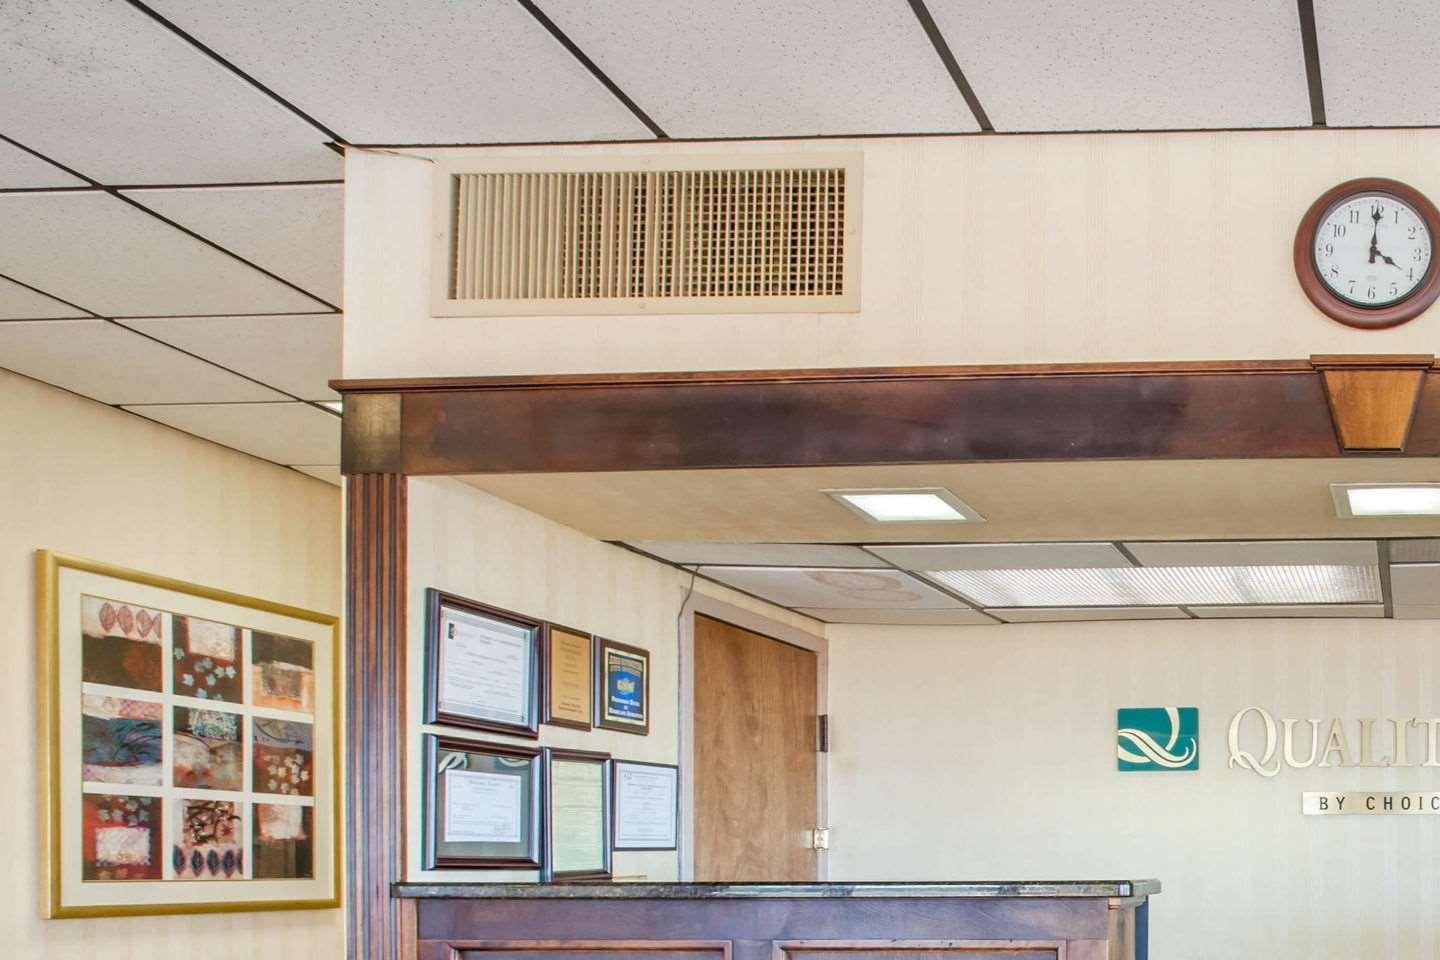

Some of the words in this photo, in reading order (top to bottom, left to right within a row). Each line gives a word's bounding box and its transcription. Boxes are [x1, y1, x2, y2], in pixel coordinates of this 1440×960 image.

[1349, 210, 1359, 224] 11
[1333, 224, 1346, 238] 10
[1408, 226, 1416, 240] 2
[1325, 244, 1333, 257] 9
[1413, 248, 1422, 262] 3
[1330, 263, 1341, 278] 8
[1406, 267, 1413, 281] 4
[1348, 280, 1357, 294] 7
[1367, 284, 1375, 299] 6
[1389, 282, 1398, 296] 5
[1319, 796, 1346, 811] BY
